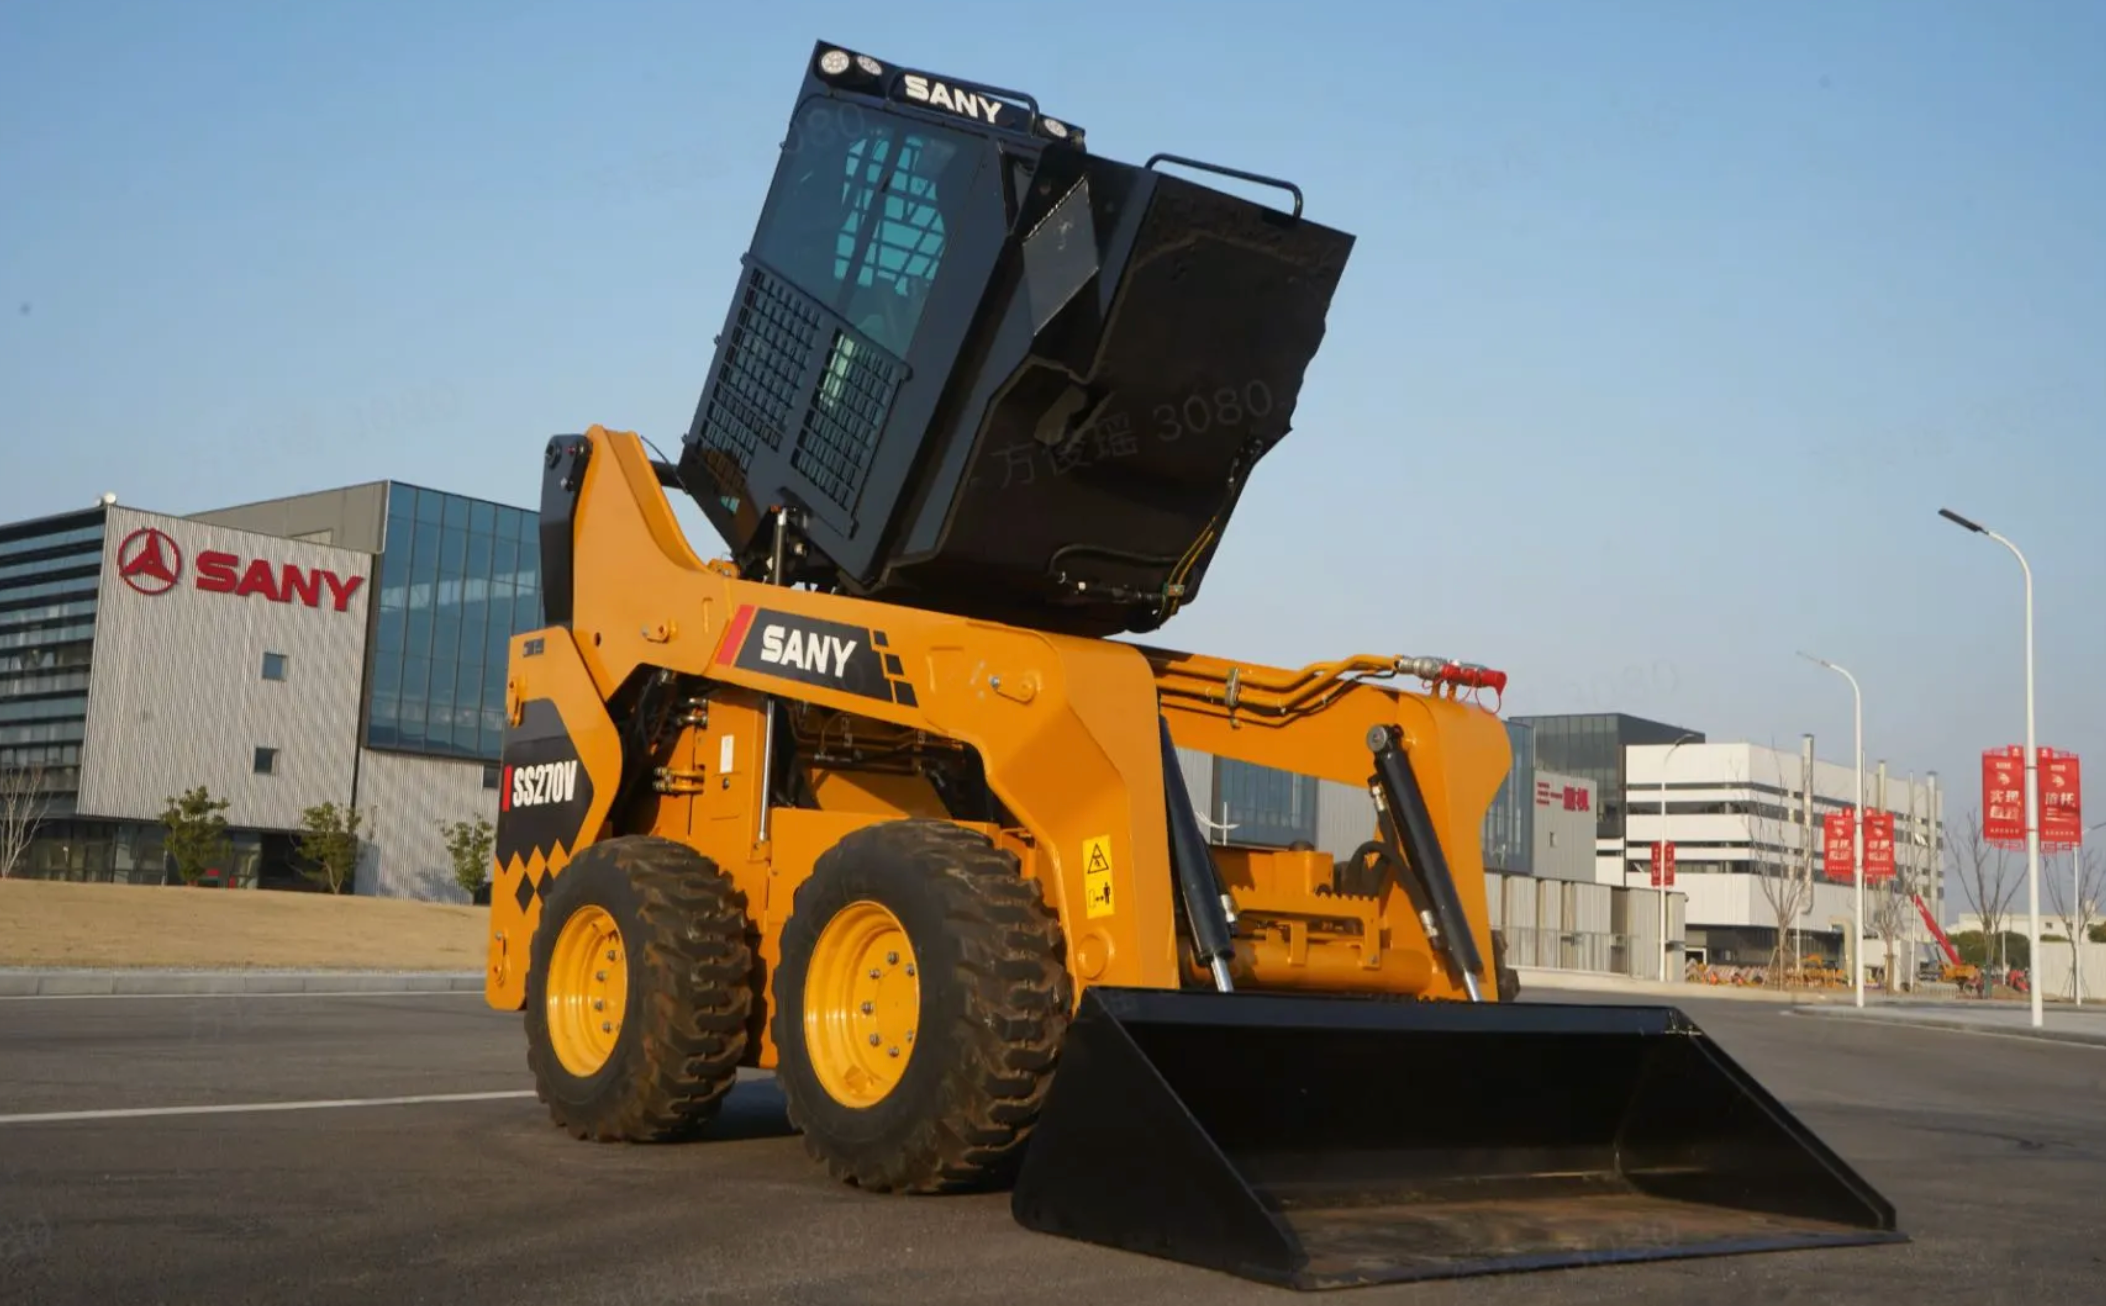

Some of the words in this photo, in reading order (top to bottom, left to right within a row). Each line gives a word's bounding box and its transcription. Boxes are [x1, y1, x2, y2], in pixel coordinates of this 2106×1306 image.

[904, 74, 1002, 124] SANY
[196, 550, 365, 612] SANY
[761, 624, 857, 678] SANY
[513, 760, 577, 807] SS270V
